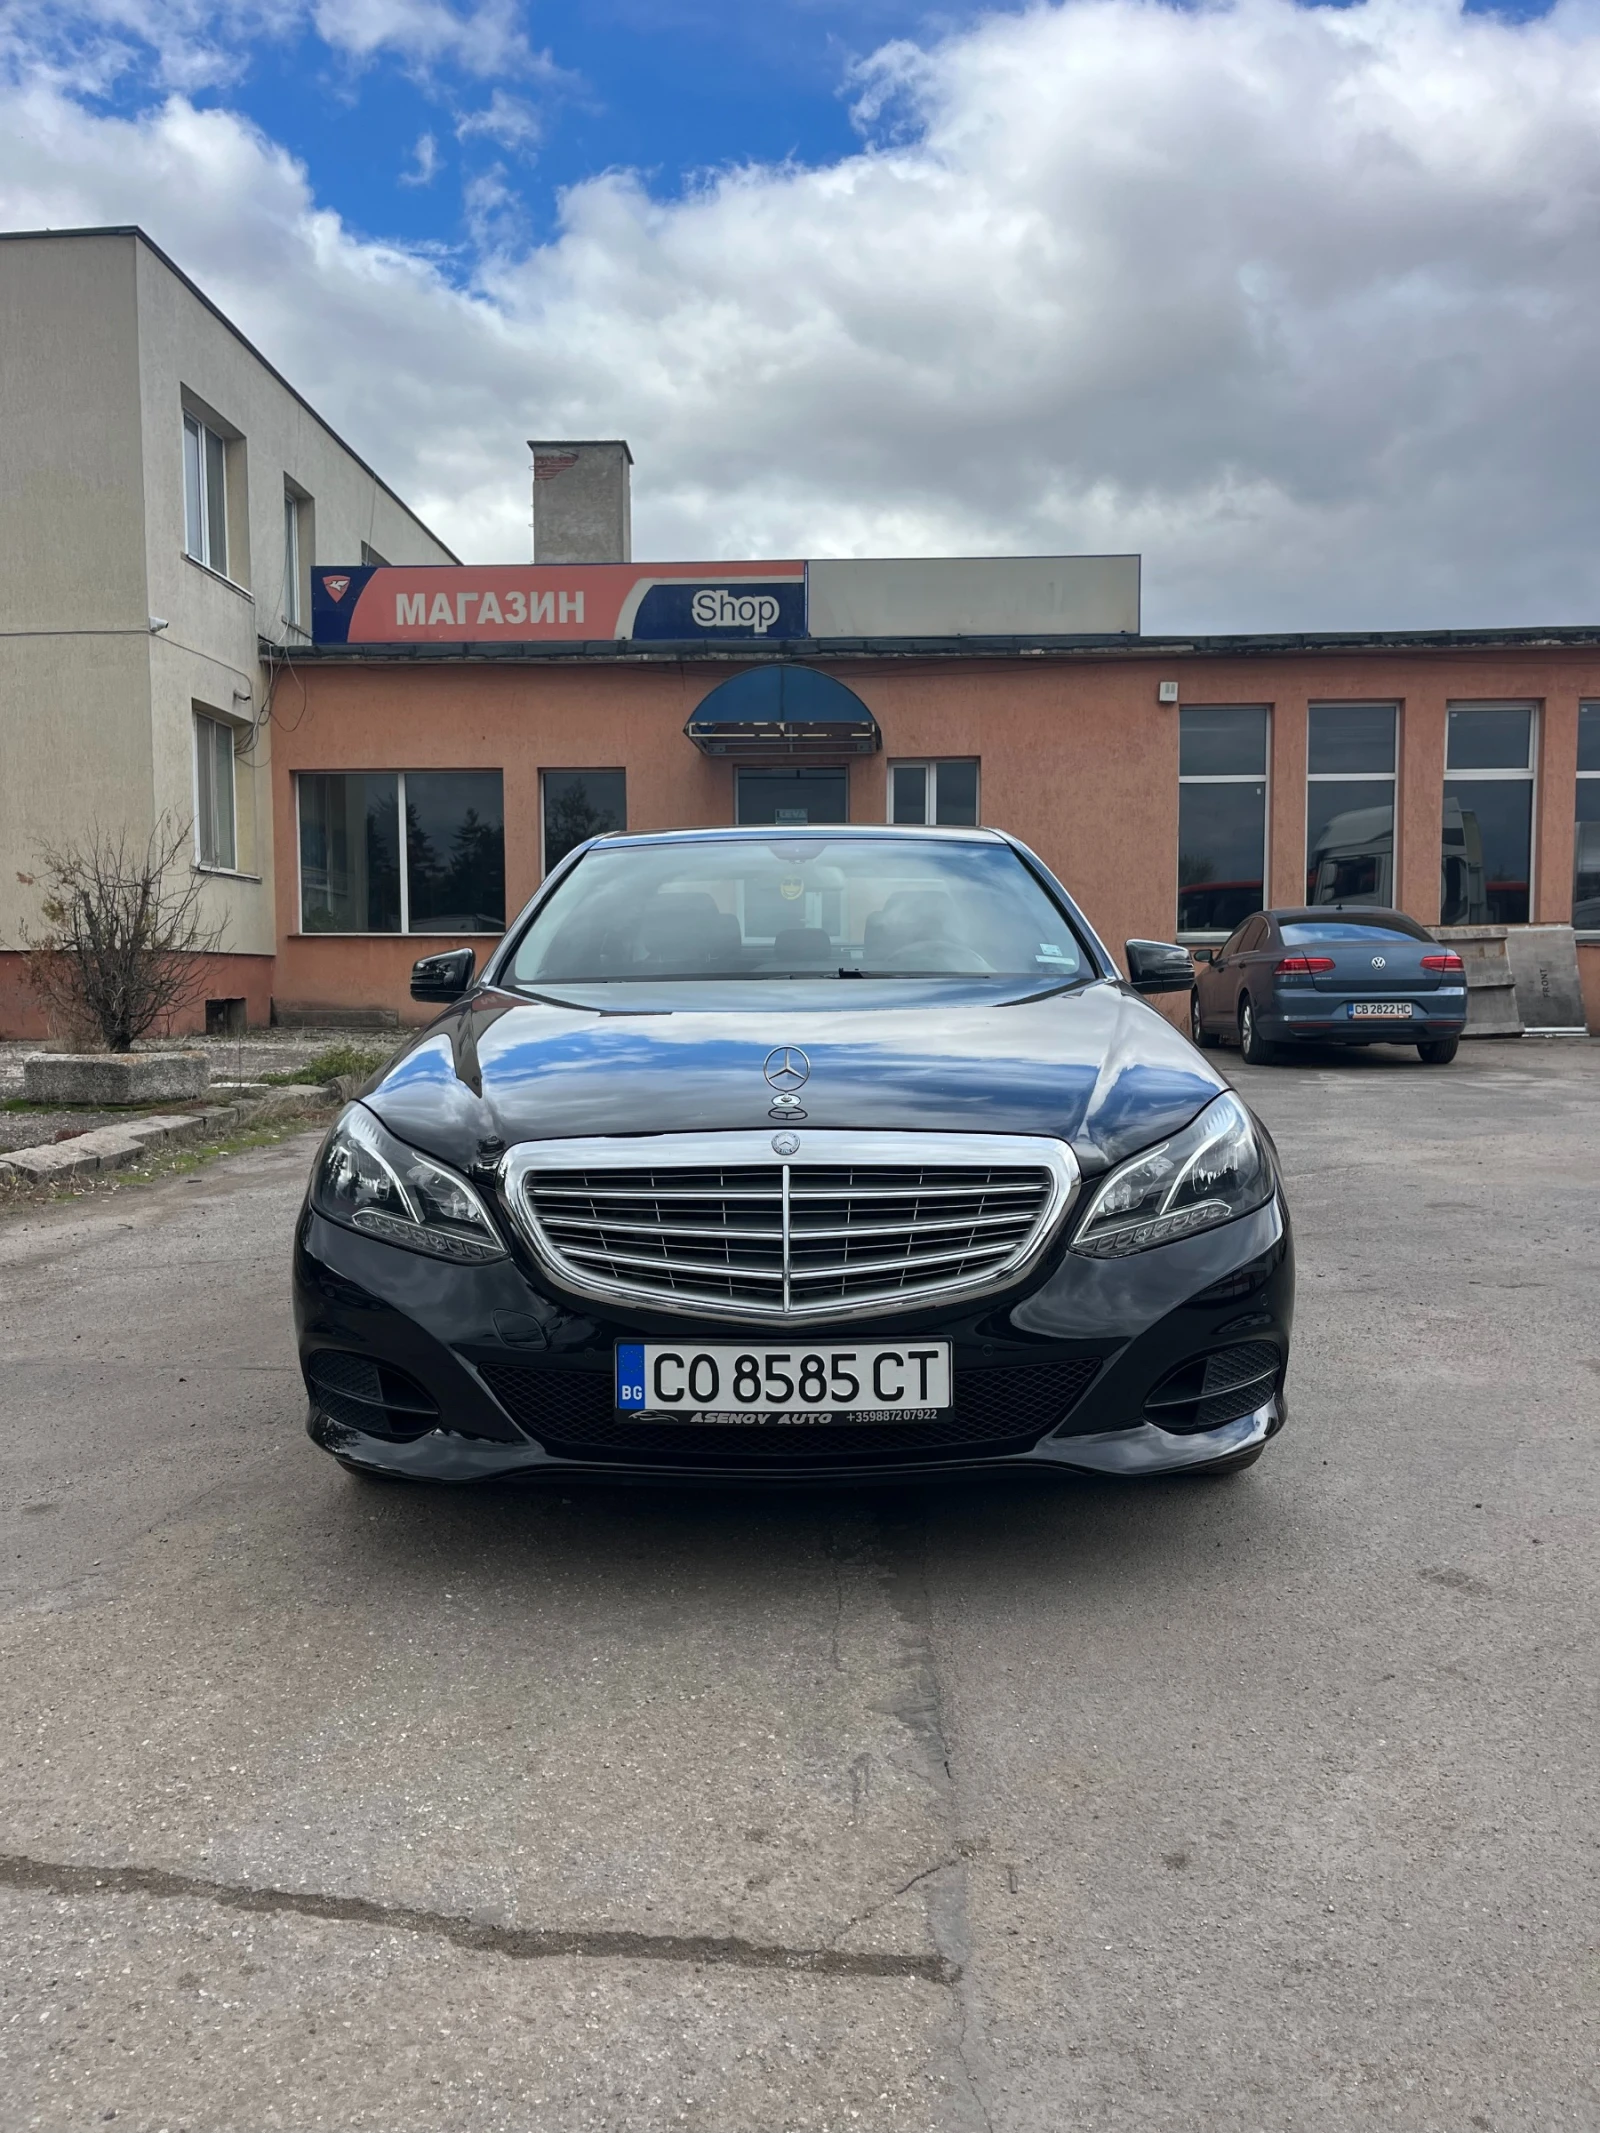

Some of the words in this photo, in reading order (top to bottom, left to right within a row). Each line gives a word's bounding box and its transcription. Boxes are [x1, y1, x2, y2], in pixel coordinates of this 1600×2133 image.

[396, 591, 585, 626] МАГАЗИН
[694, 592, 778, 630] Shop
[1540, 969, 1551, 998] FRONT
[1355, 1004, 1369, 1015] CB
[1370, 1004, 1395, 1014] 2822
[1397, 1004, 1411, 1014] HC
[733, 1353, 860, 1404] 8585
[873, 1350, 940, 1402] CT
[621, 1385, 643, 1401] BG
[690, 1412, 770, 1425] ASENOV
[777, 1413, 833, 1425] AUTO
[846, 1409, 938, 1423] +359887207922
